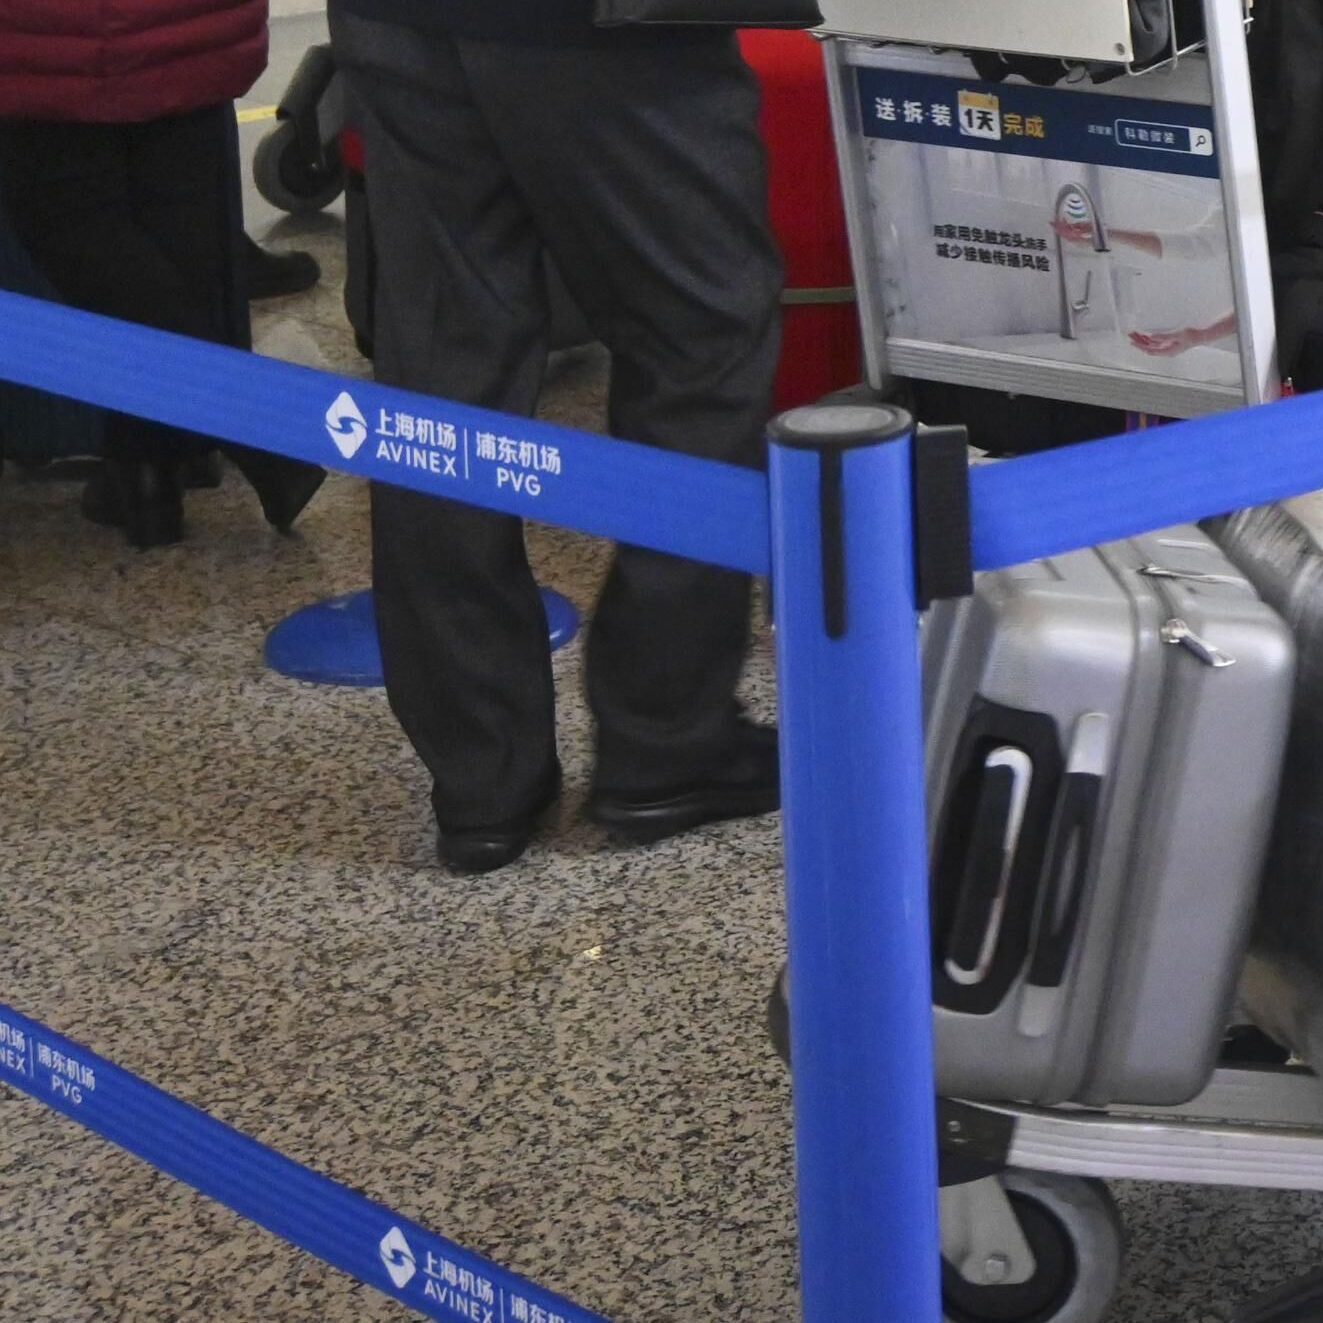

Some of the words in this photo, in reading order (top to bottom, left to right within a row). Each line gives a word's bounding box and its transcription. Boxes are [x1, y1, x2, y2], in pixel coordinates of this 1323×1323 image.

[964, 108, 994, 132] 1天
[1003, 113, 1045, 139] 完成
[375, 408, 456, 451] 上海机场
[476, 430, 561, 475] 浦东机场
[376, 439, 456, 477] AVINEX
[497, 467, 541, 496] PVG
[38, 1042, 95, 1091] 浦东机场
[52, 1074, 82, 1104] PVG
[424, 1251, 493, 1306] 上海机场
[424, 1280, 493, 1323] AVINEX
